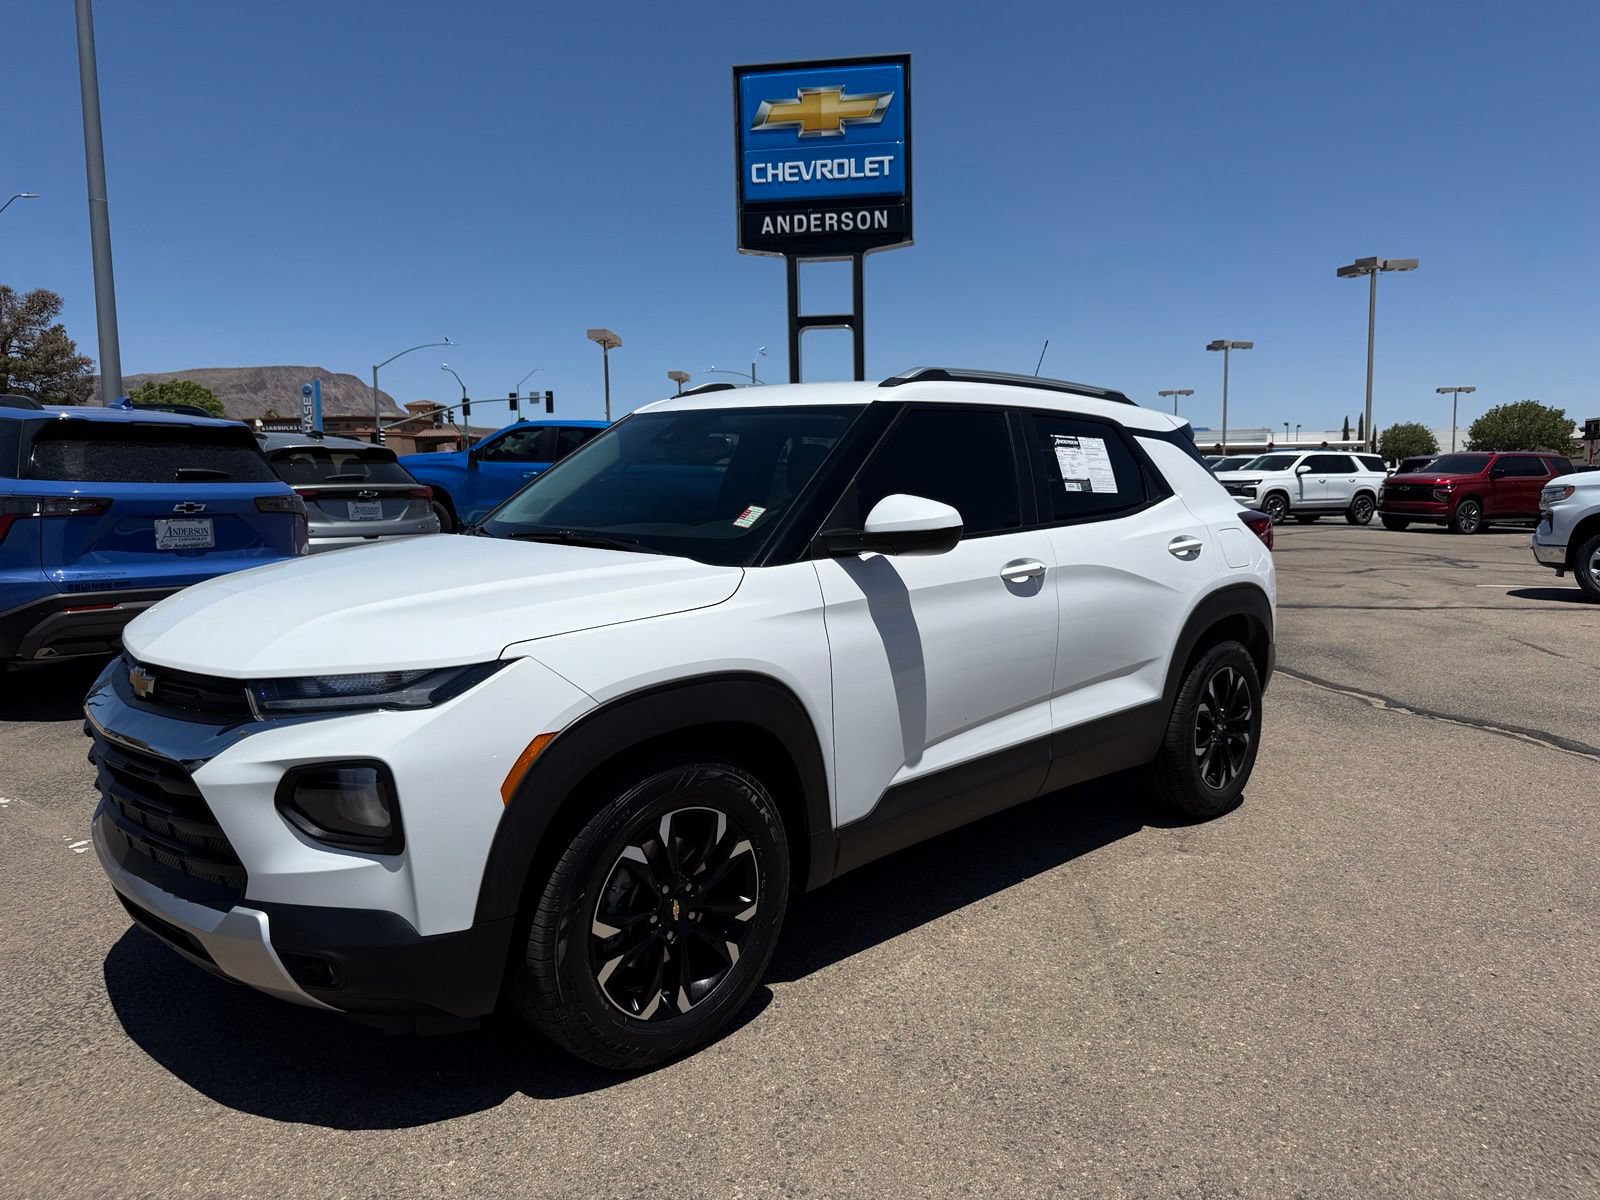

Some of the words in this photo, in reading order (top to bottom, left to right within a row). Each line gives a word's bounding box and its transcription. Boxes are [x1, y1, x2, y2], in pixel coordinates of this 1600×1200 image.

[751, 155, 894, 184] CHEVROLET
[761, 209, 888, 235] ANDERSON
[303, 397, 313, 434] HASE
[161, 526, 209, 542] ANDERSON
